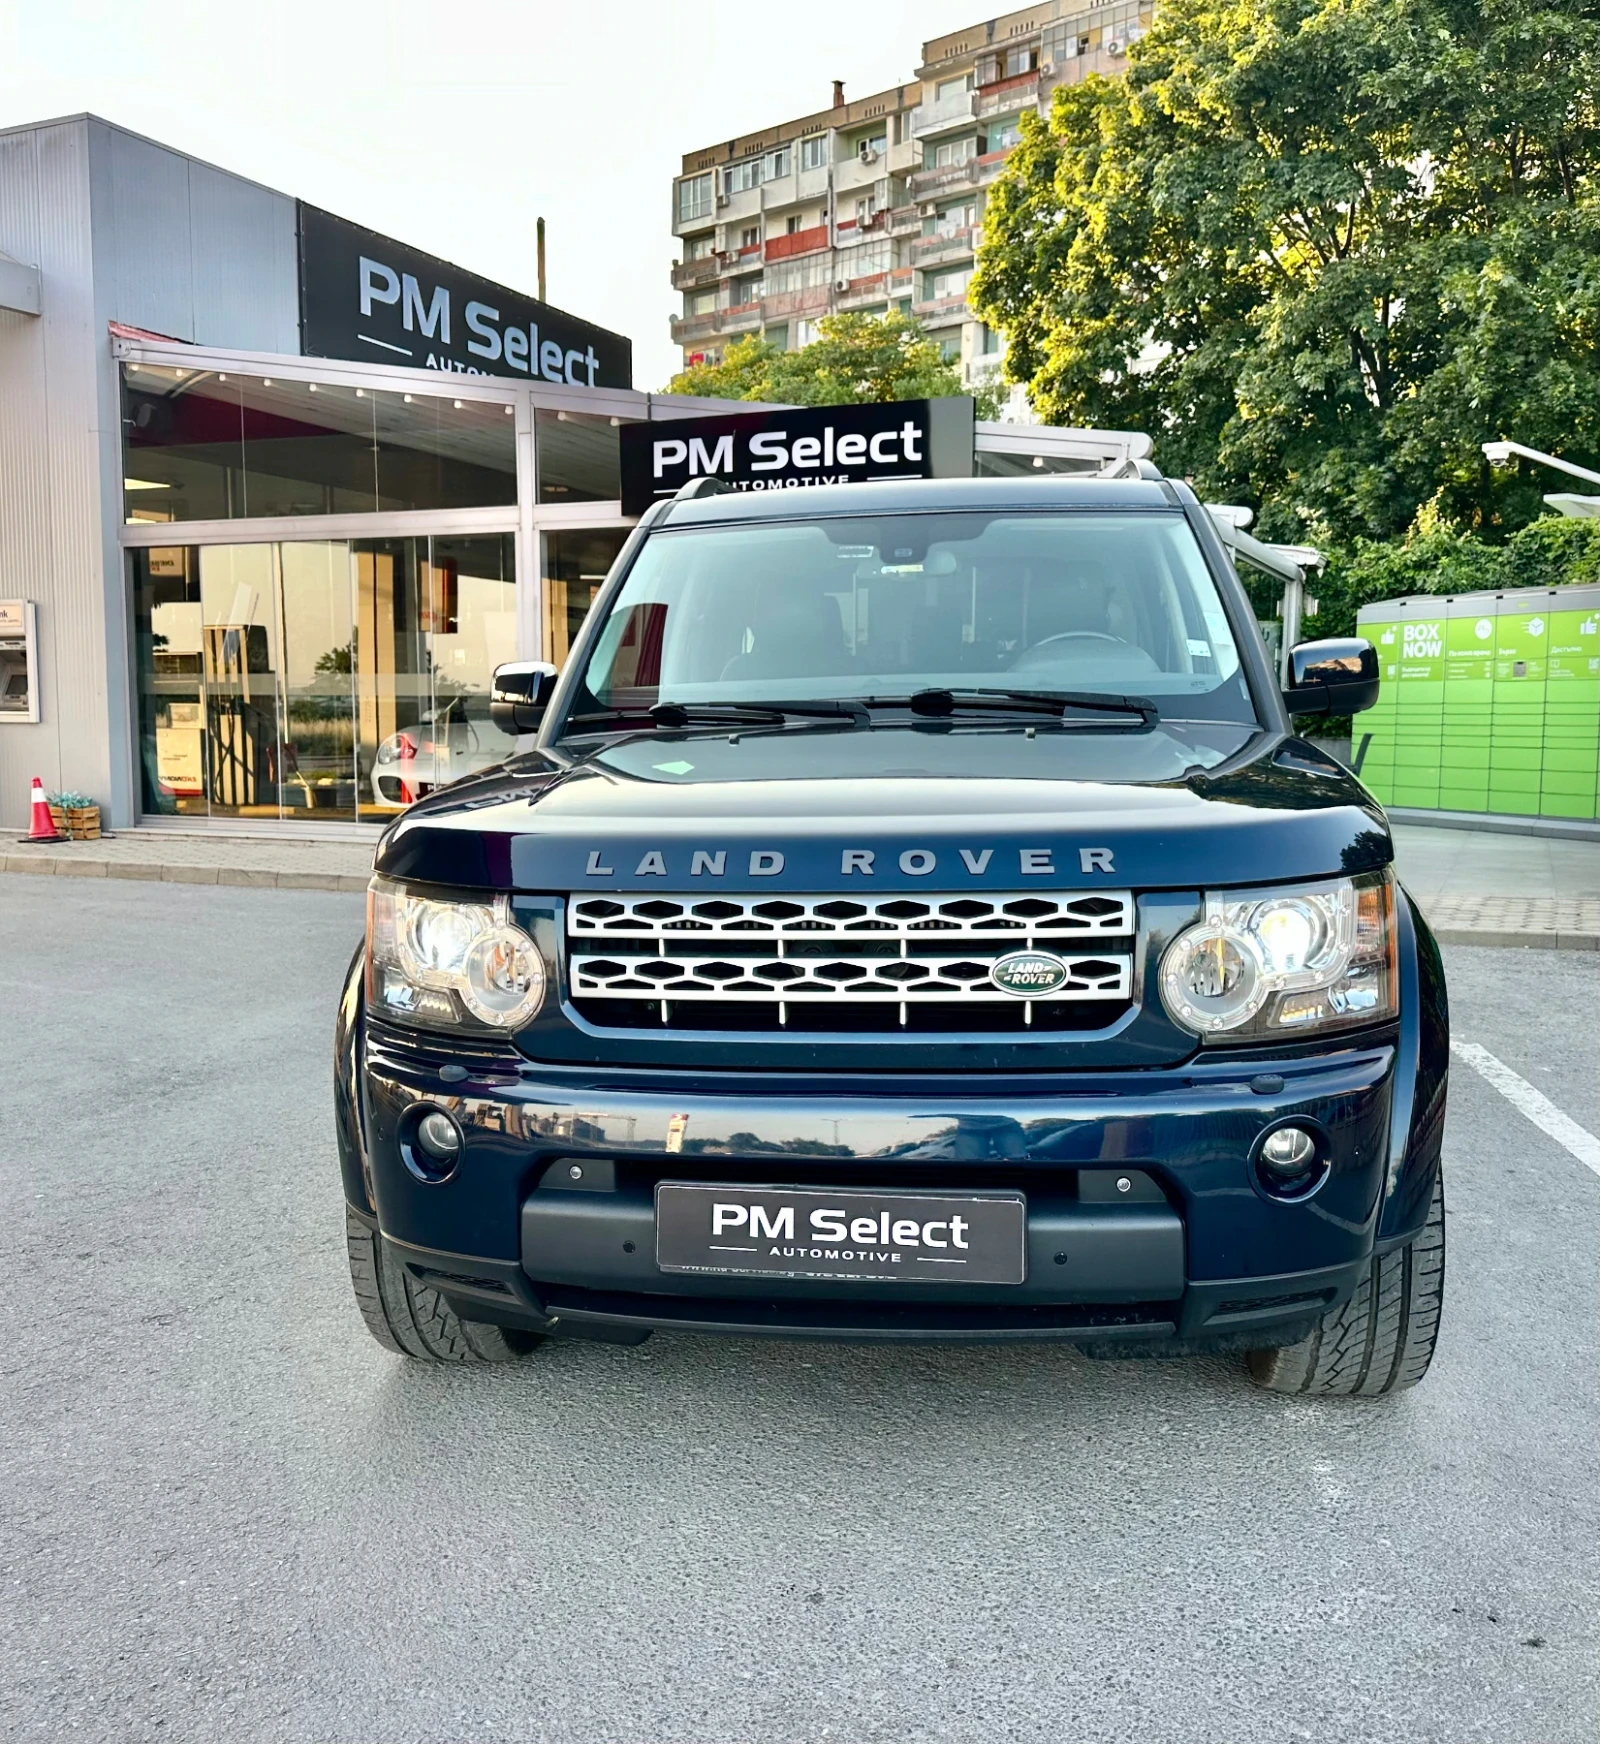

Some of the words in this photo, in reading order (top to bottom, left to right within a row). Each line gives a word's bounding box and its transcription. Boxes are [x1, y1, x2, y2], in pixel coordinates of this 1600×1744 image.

[359, 256, 450, 345] PM
[464, 301, 600, 388] Select
[653, 435, 734, 478] PM
[749, 421, 923, 472] Select
[1403, 623, 1440, 641] BOX
[1403, 640, 1442, 658] NOW
[585, 850, 786, 877] LAND
[840, 847, 1117, 876] ROVER
[1007, 962, 1044, 974] LAND
[1011, 973, 1056, 985] ROVER
[712, 1203, 795, 1240] PM
[809, 1209, 969, 1249] Select
[769, 1246, 902, 1263] AUTOMOTIVE
